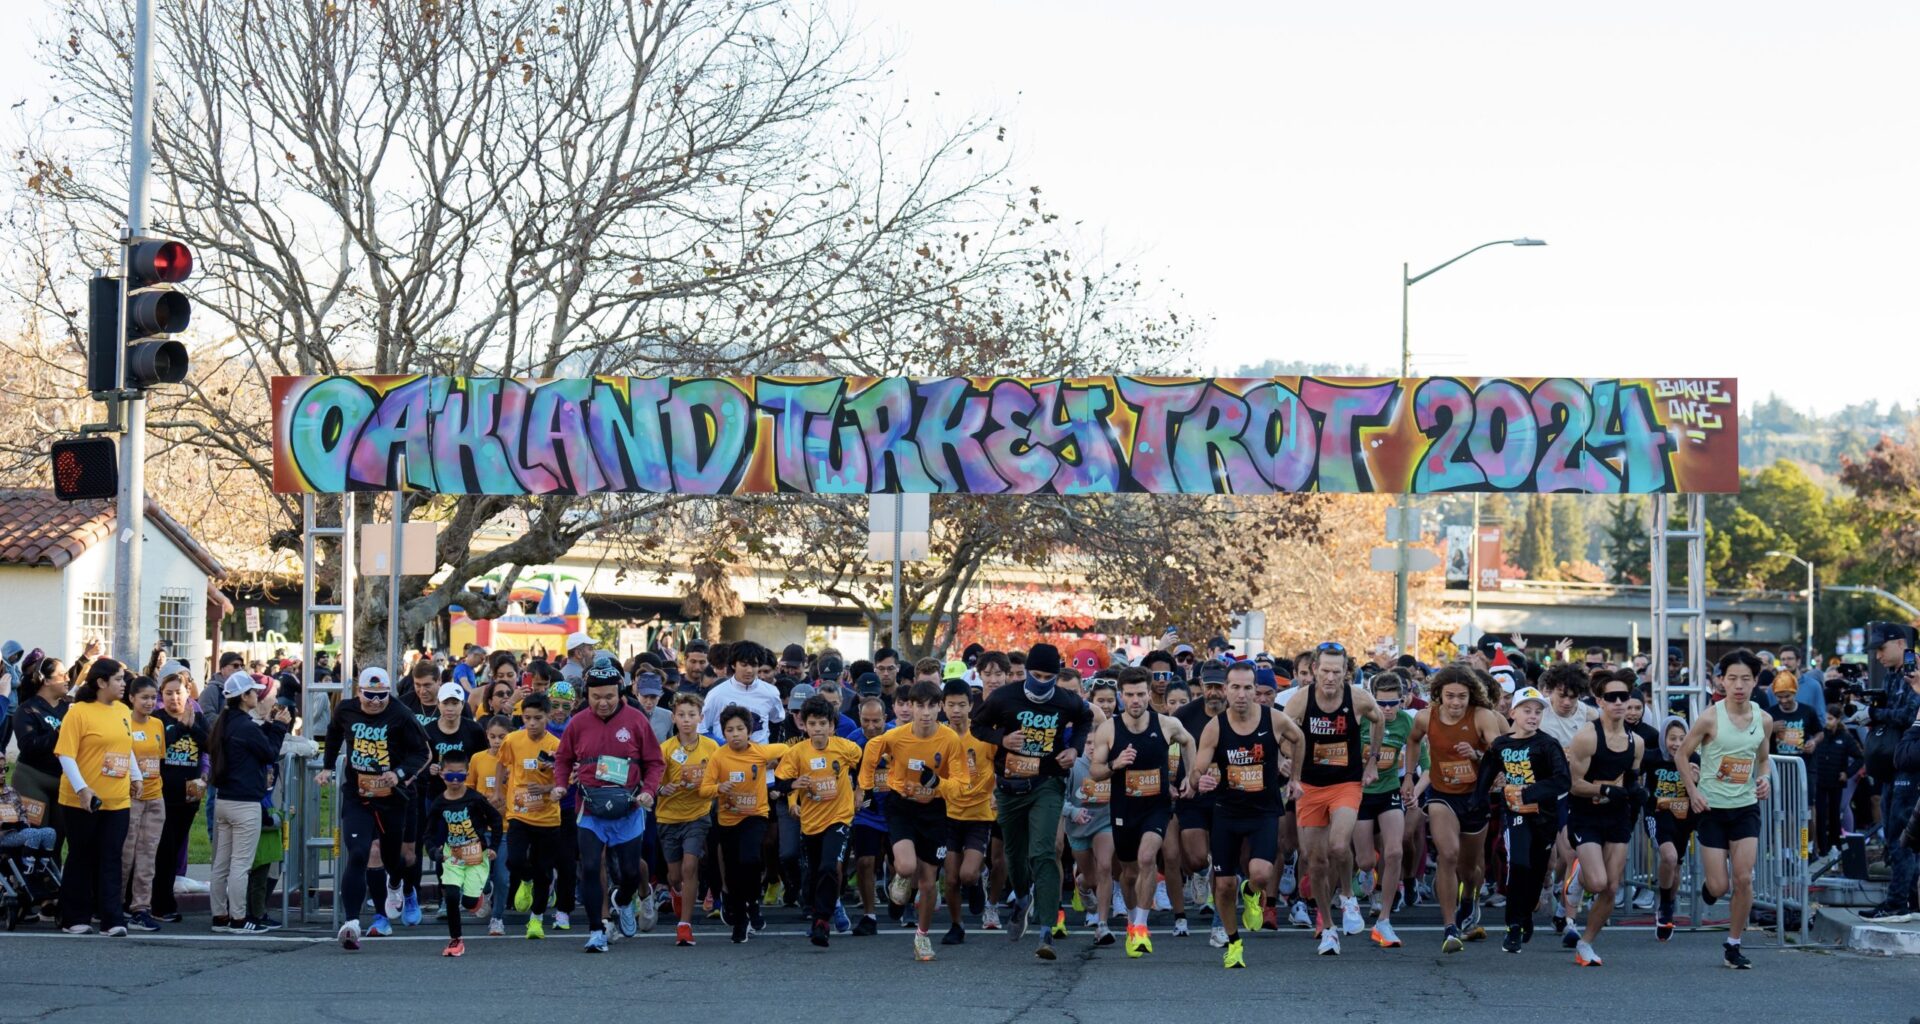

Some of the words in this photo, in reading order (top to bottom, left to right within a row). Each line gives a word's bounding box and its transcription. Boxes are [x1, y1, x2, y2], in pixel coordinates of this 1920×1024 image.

[1668, 399, 1723, 429] ONE
[290, 377, 754, 493] OAKLAND
[756, 377, 1126, 493] TURKEY
[1113, 377, 1400, 493] TROT
[1413, 377, 1676, 493] 2024
[1016, 711, 1059, 729] Best
[1310, 716, 1332, 728] WEST
[1784, 718, 1804, 729] est
[351, 722, 388, 741] Best
[1310, 726, 1336, 735] VALLEY
[354, 738, 376, 756] LEG
[435, 741, 464, 755] Best
[1226, 749, 1250, 759] WEST
[1227, 756, 1254, 765] VALLEY
[1380, 751, 1395, 760] 700
[1501, 747, 1530, 762] Best
[1240, 770, 1263, 781] 3023
[1654, 768, 1680, 781] Bes
[816, 780, 837, 791] 3412
[442, 806, 470, 823] Best
